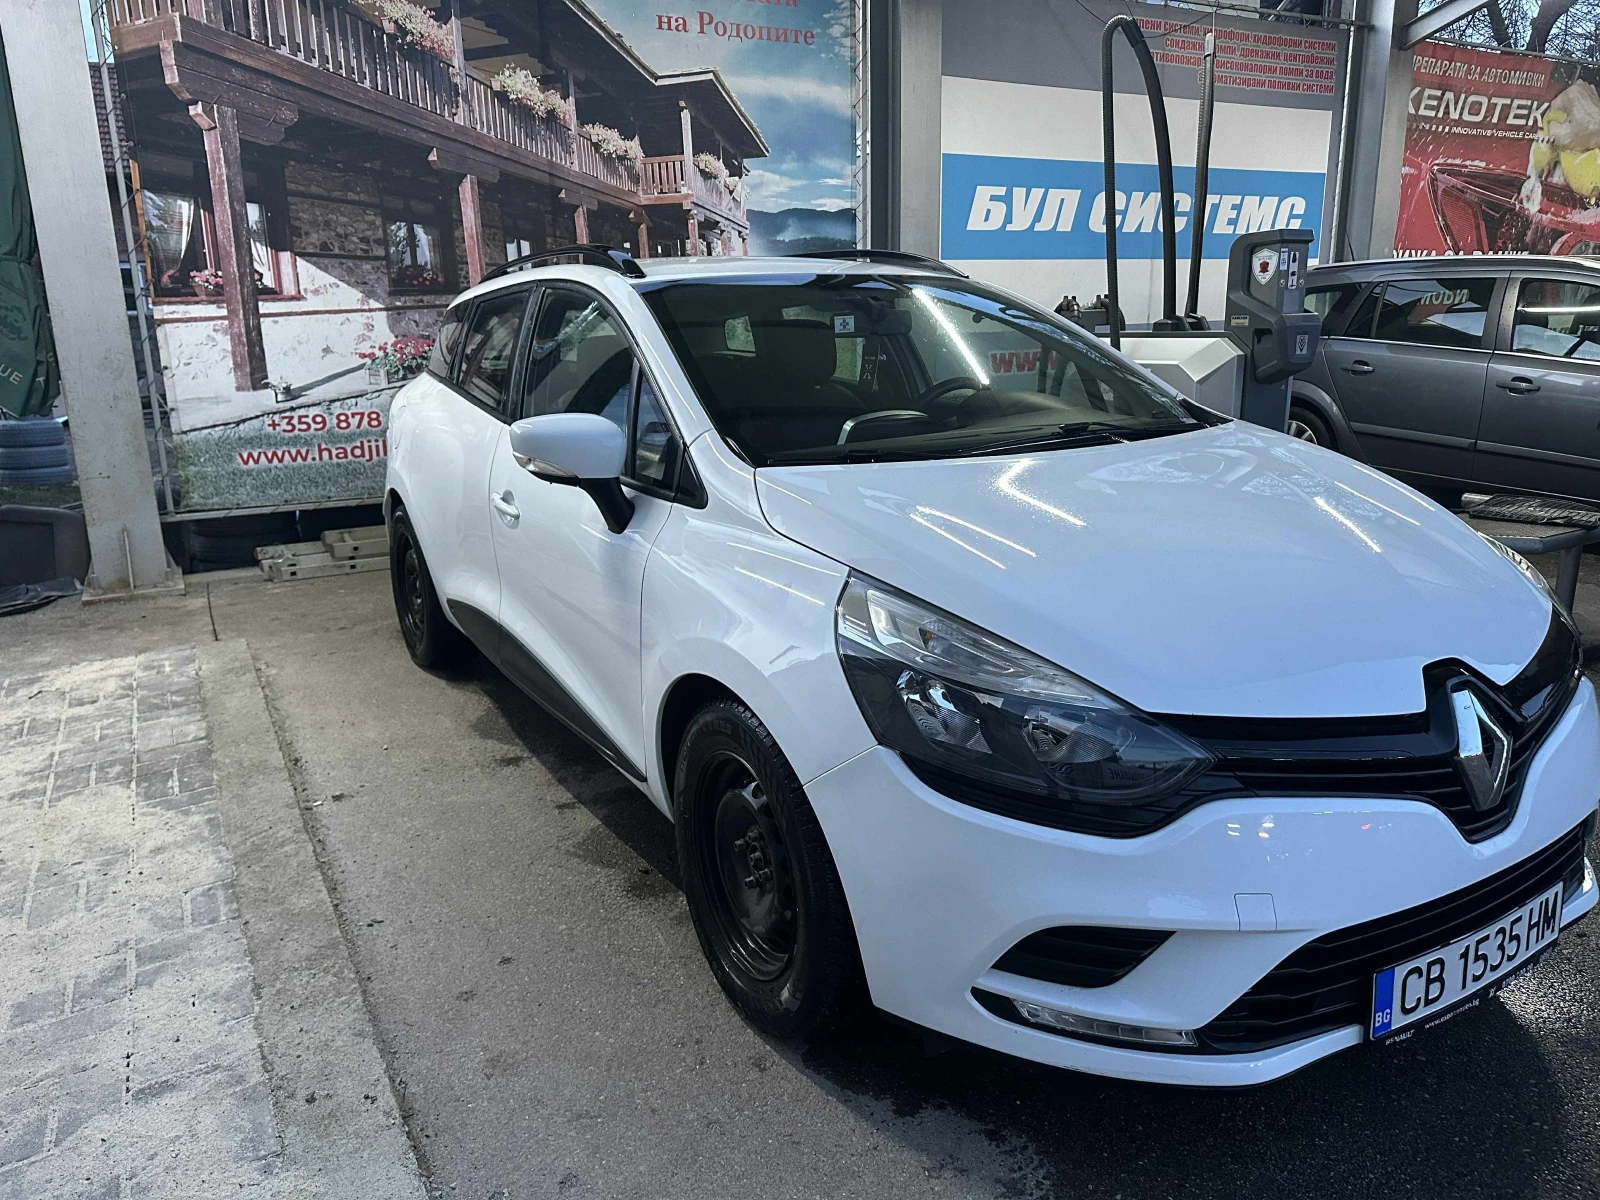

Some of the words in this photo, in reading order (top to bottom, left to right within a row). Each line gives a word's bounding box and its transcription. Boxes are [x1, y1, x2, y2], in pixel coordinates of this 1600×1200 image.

[655, 14, 689, 33] на
[697, 10, 815, 46] Родопите
[1164, 37, 1205, 52] сондажн
[1278, 65, 1304, 78] помпи
[1304, 68, 1314, 79] за
[1468, 64, 1481, 80] ЗА
[1481, 67, 1545, 88] АВТОМИВКИ
[1267, 79, 1301, 92] поливни
[1301, 82, 1334, 95] системи
[1408, 86, 1551, 128] KENOTEK
[1451, 126, 1491, 136] INNOVATIVE
[1493, 130, 1525, 138] VEHICLE
[1525, 132, 1540, 140] CARE
[966, 185, 1082, 232] БУЛ
[267, 413, 327, 434] +359
[335, 411, 383, 431] 878
[1400, 956, 1446, 1016] CB
[1458, 914, 1523, 992] 1535
[1525, 890, 1559, 952] HM
[1374, 1011, 1391, 1028] BG
